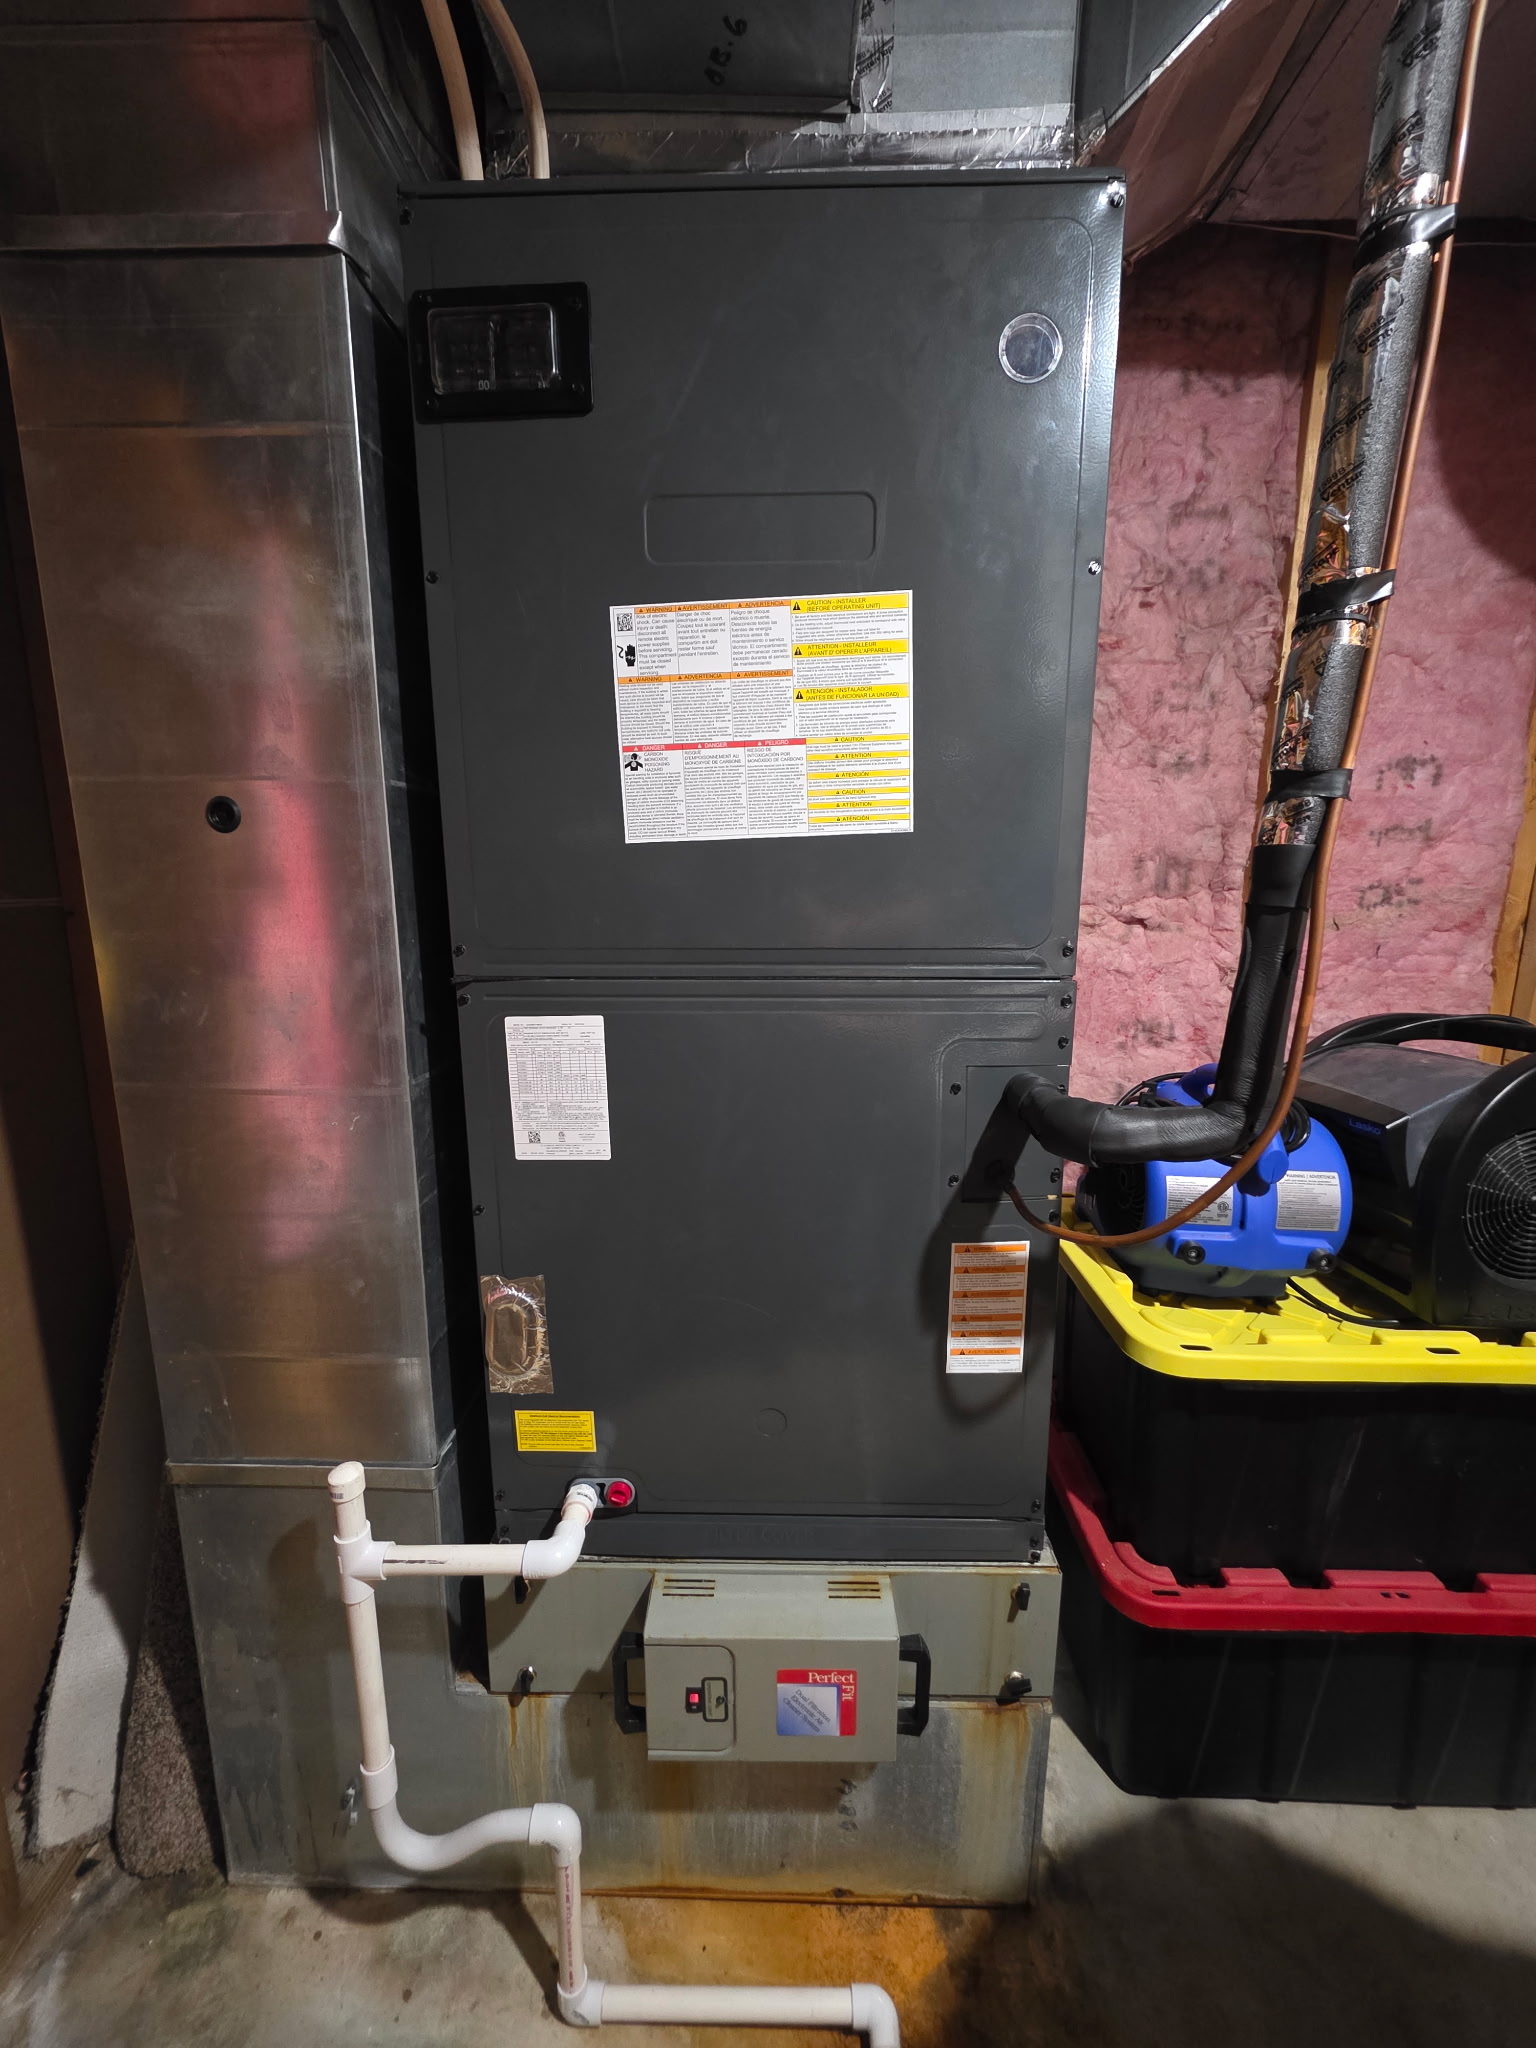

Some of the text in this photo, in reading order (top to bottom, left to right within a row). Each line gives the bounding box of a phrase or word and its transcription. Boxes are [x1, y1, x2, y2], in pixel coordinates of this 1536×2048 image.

[808, 1672, 855, 1684] Perfect
[842, 1685, 855, 1702] Fit
[783, 1697, 820, 1733] Cleaner System
[791, 1695, 816, 1717] Electronic
[795, 1689, 831, 1722] Dual Filtration
